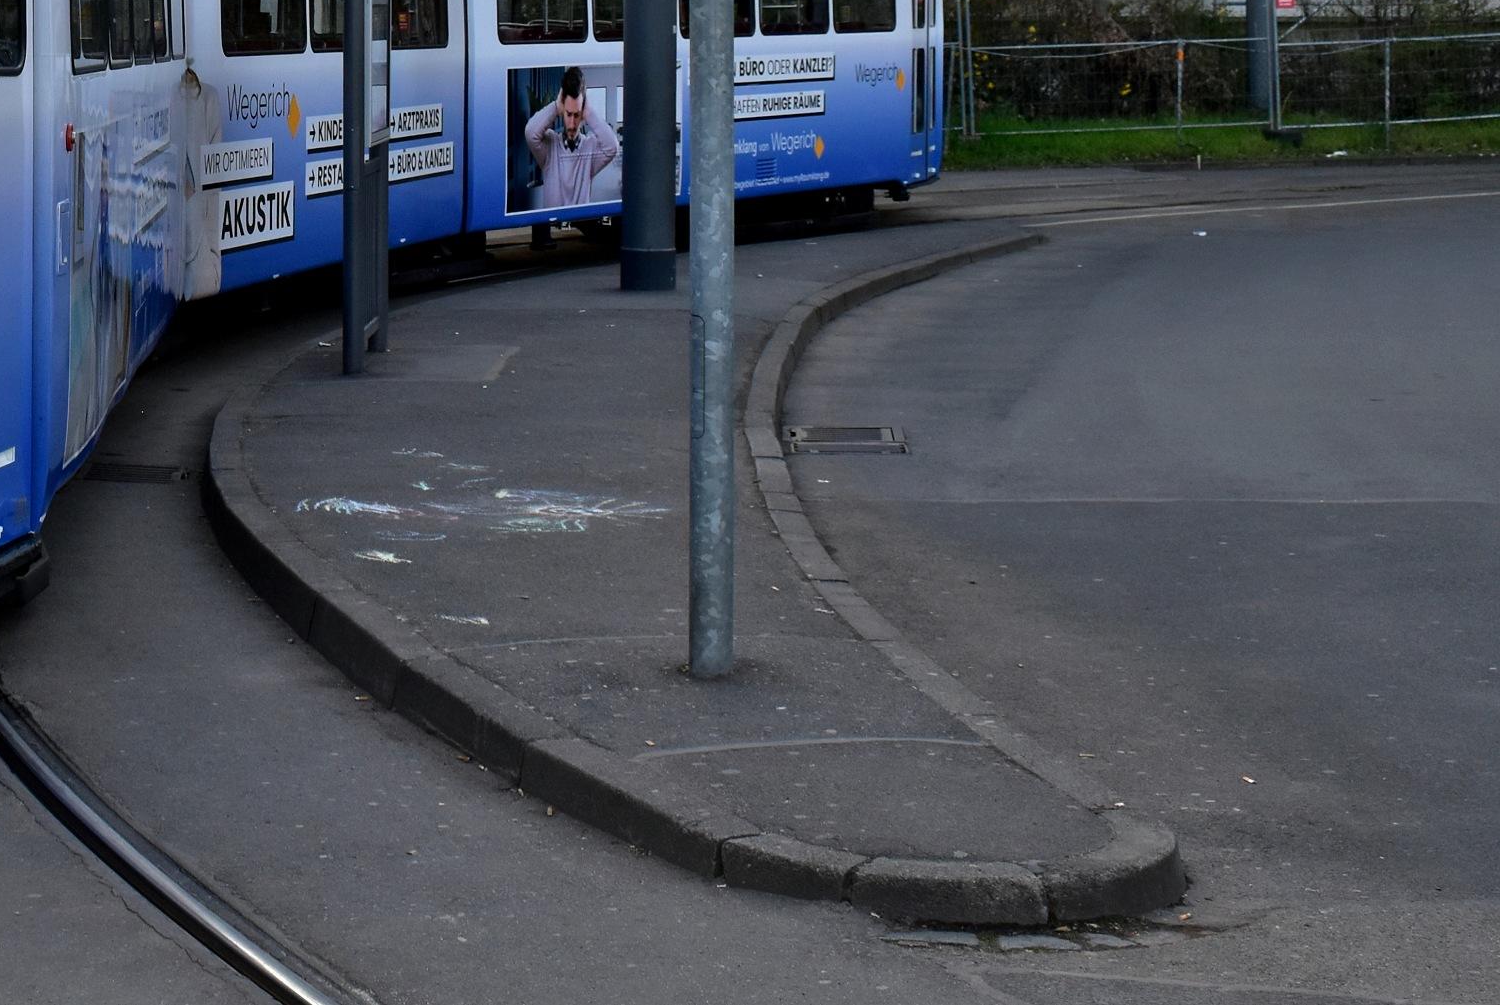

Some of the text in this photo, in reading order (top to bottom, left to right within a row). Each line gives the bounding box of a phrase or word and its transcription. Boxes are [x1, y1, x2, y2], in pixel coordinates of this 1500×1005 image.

[739, 57, 765, 76] BÜRO
[768, 58, 791, 76] ODER
[792, 56, 834, 75] KANZLEI?
[855, 62, 899, 87] Wegerich
[227, 82, 290, 129] Wegerich
[763, 96, 792, 113] RUHIGE
[793, 92, 821, 110] RÄUME
[318, 108, 440, 142] KINDE ARZTPRAXIS
[771, 129, 818, 155] Wegerich
[204, 149, 269, 176] WIR OPTIMIEREN
[317, 163, 343, 185] RESTA
[397, 148, 417, 174] BÜRO
[424, 147, 452, 170] KANZLEI
[221, 190, 292, 240] AKUSTIK
